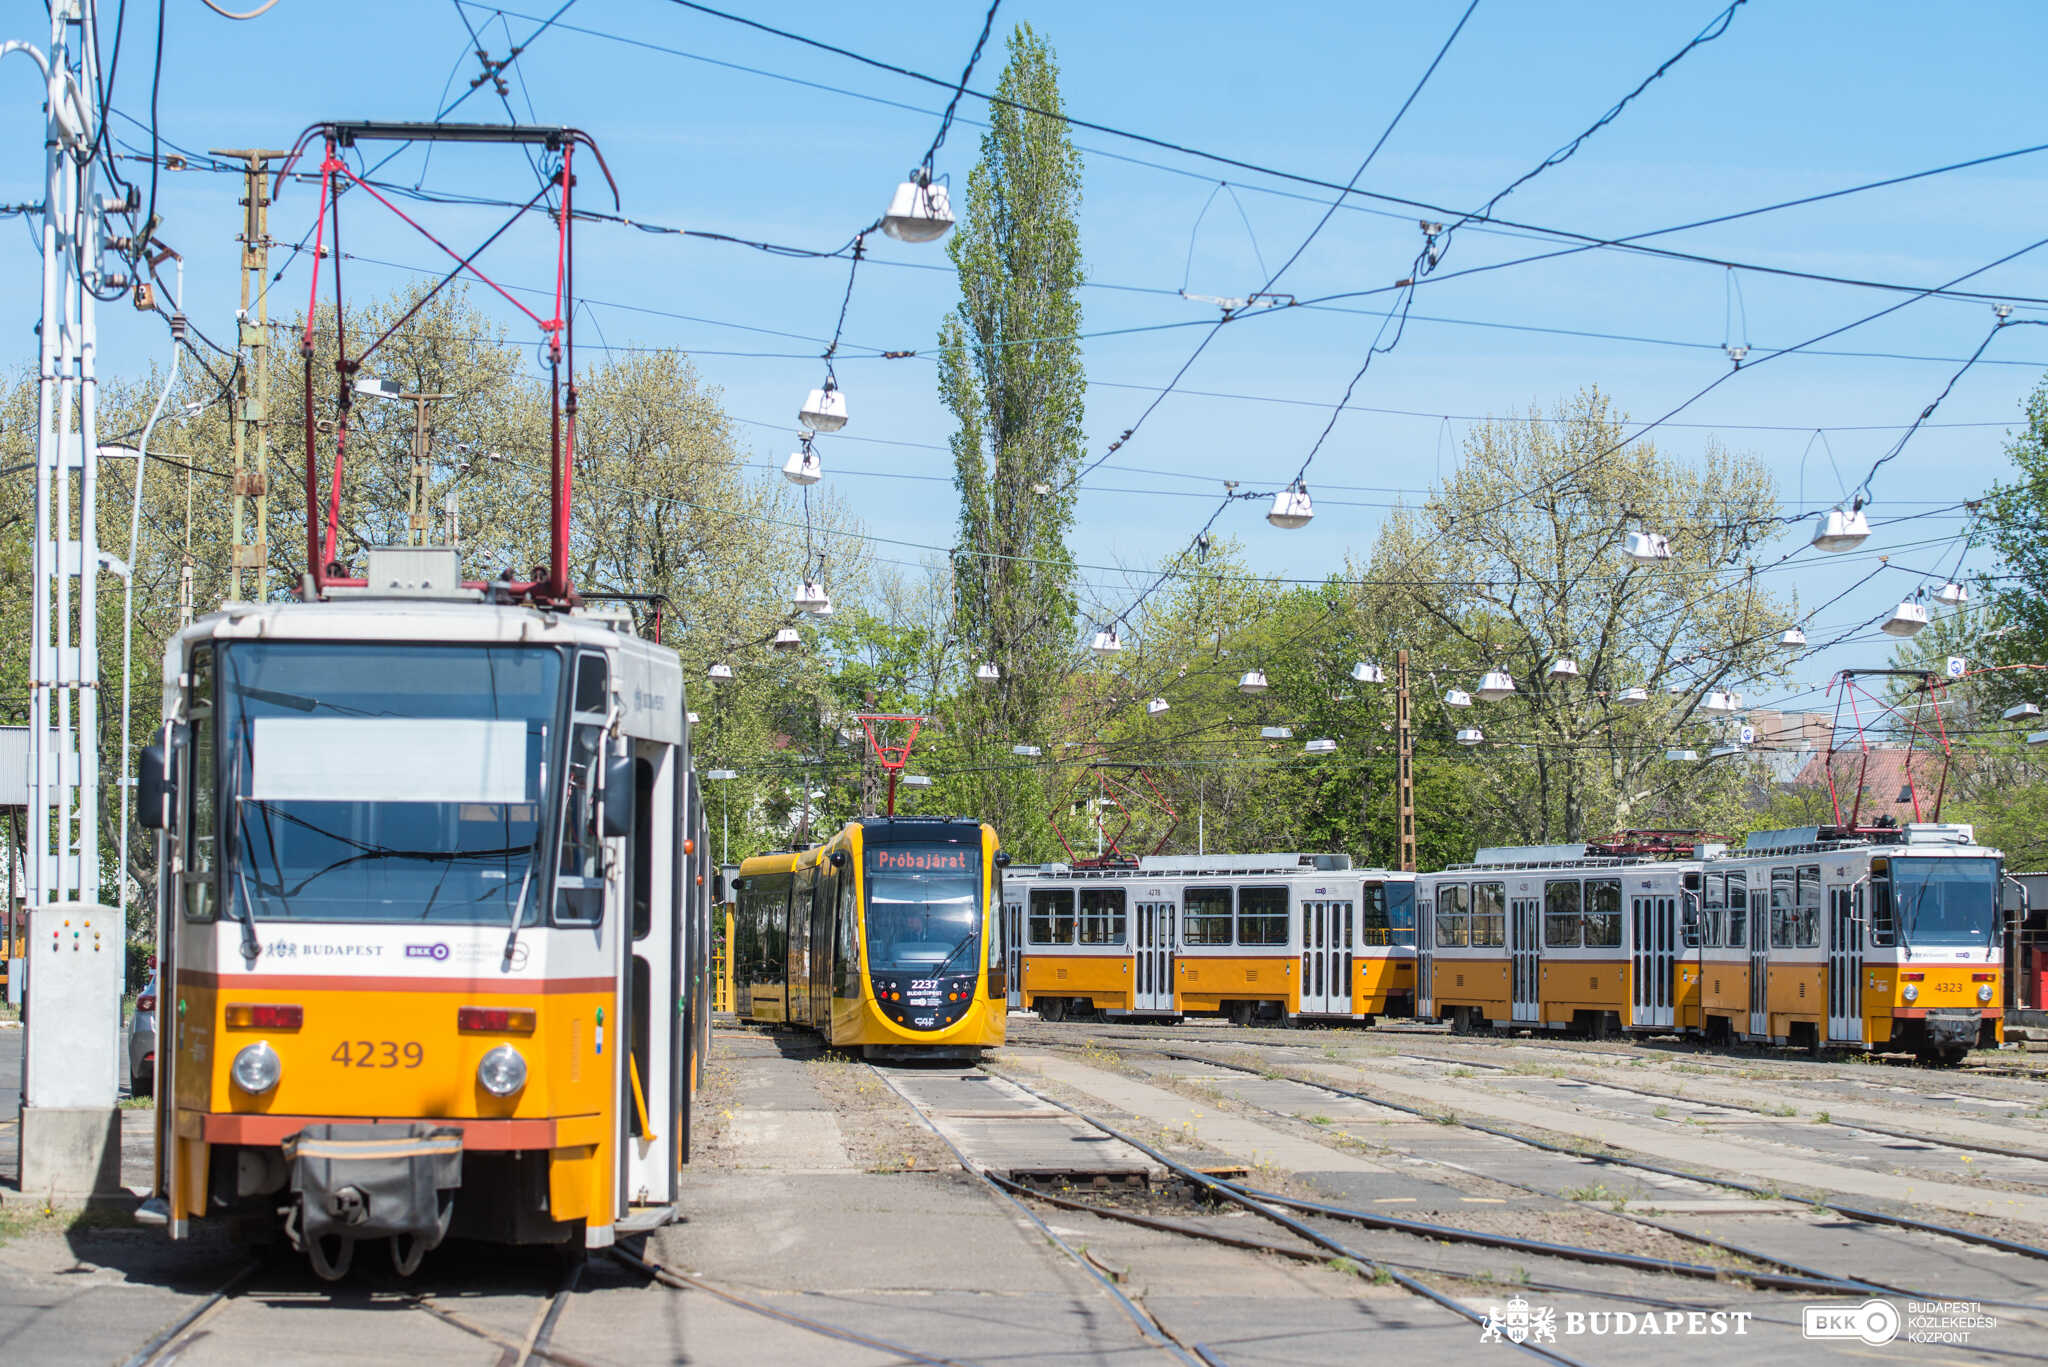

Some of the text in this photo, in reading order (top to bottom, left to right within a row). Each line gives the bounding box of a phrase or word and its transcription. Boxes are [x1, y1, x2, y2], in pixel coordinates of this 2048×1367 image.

[879, 851, 966, 870] Próbajárat
[303, 945, 384, 956] BUDAPEST
[911, 980, 938, 989] 2237
[1935, 983, 1963, 992] 4323
[330, 1040, 424, 1068] 4239
